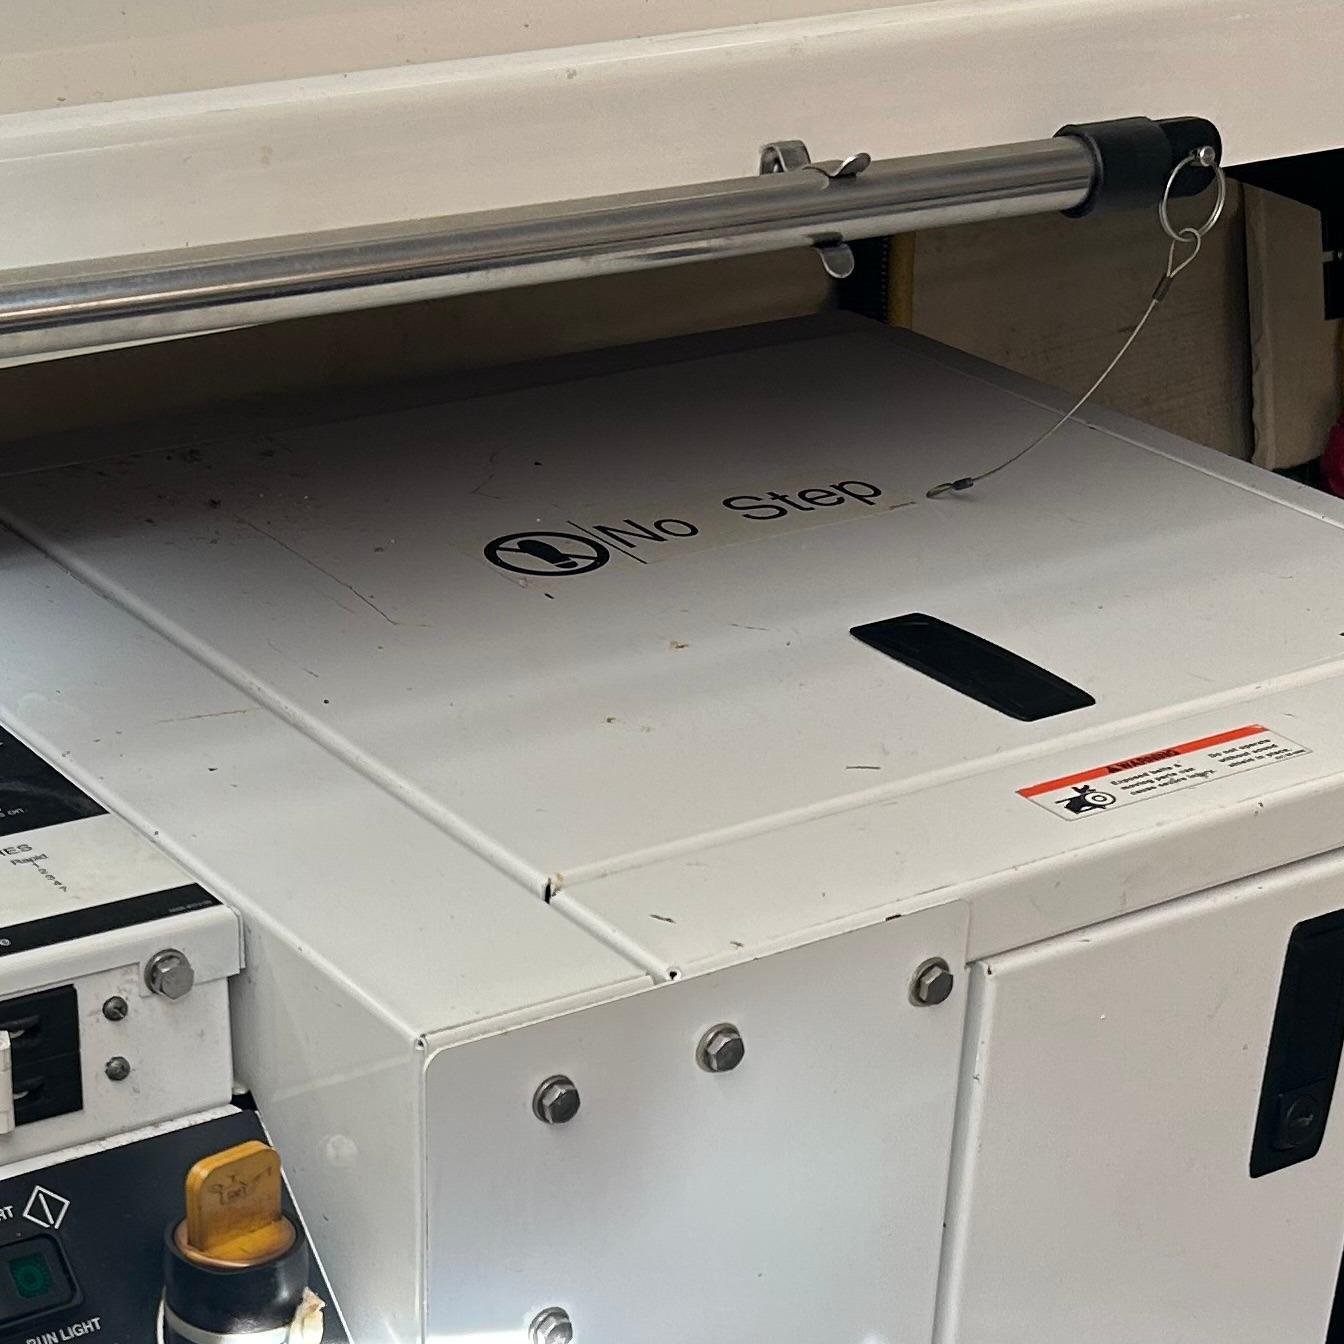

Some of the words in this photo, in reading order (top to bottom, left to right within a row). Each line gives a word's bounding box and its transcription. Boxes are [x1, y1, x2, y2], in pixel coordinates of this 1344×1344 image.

[593, 519, 699, 549] No
[722, 480, 882, 521] Step
[10, 853, 47, 865] Rapid
[59, 1317, 100, 1340] LIGHT
